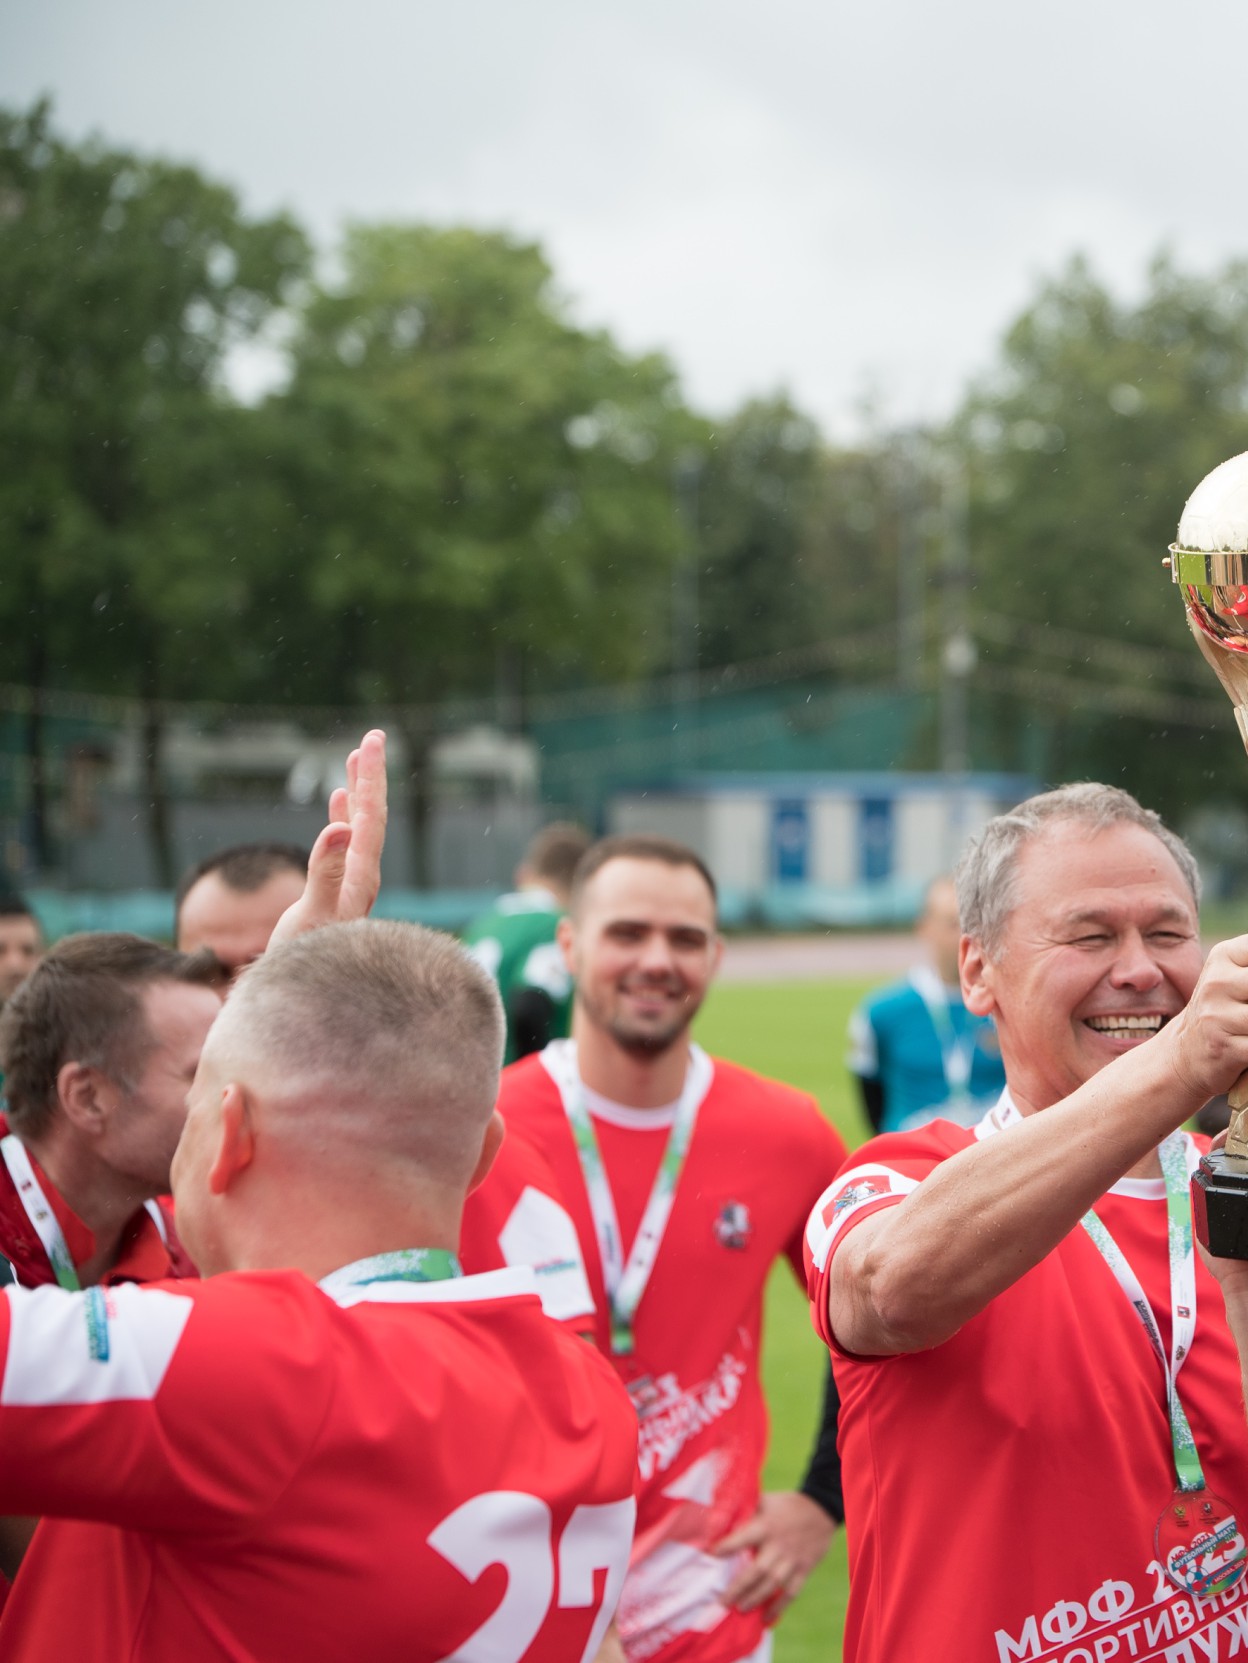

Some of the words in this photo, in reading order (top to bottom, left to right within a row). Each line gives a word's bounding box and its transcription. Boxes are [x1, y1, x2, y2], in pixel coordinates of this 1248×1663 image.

[426, 1490, 637, 1663] 27
[1174, 1535, 1218, 1568] ФУТБОЛЬНЫЙ
[1217, 1523, 1236, 1540] МАТЧ
[994, 1578, 1135, 1663] МФФ
